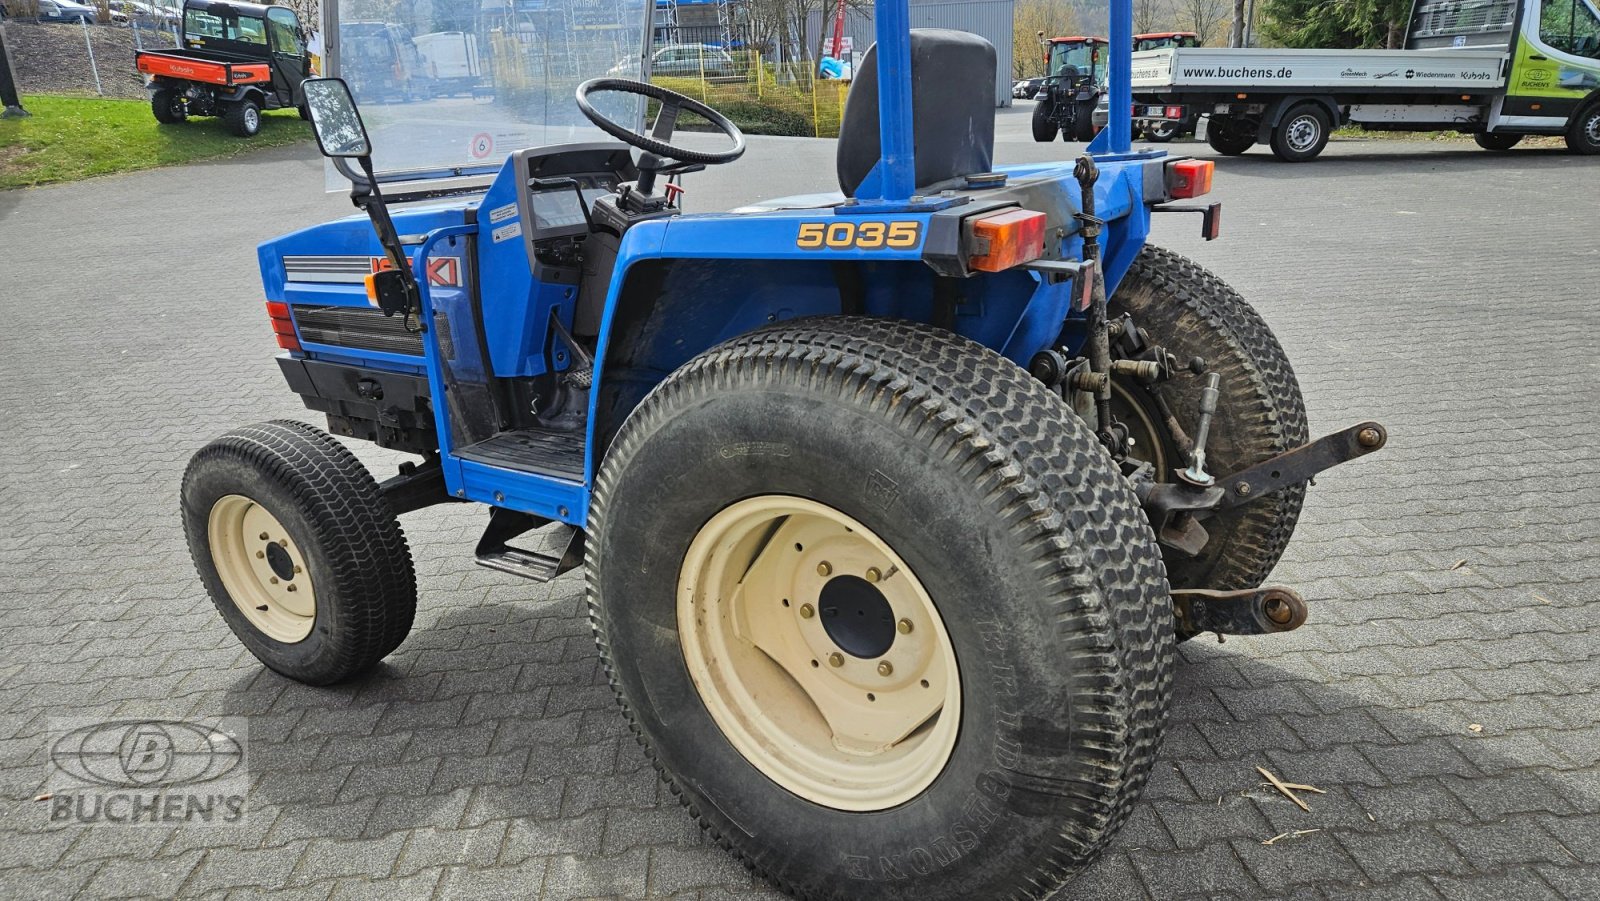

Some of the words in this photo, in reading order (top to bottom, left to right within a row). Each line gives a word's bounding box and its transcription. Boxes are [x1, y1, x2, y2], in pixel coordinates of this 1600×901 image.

[1183, 66, 1293, 79] www.buchens.de
[1416, 71, 1457, 79] Wiedenmann
[1460, 71, 1491, 80] Kubota
[478, 140, 486, 151] 6
[796, 221, 922, 249] 5035
[372, 257, 458, 286] IKI
[845, 615, 1023, 882] BRIDGESTONE
